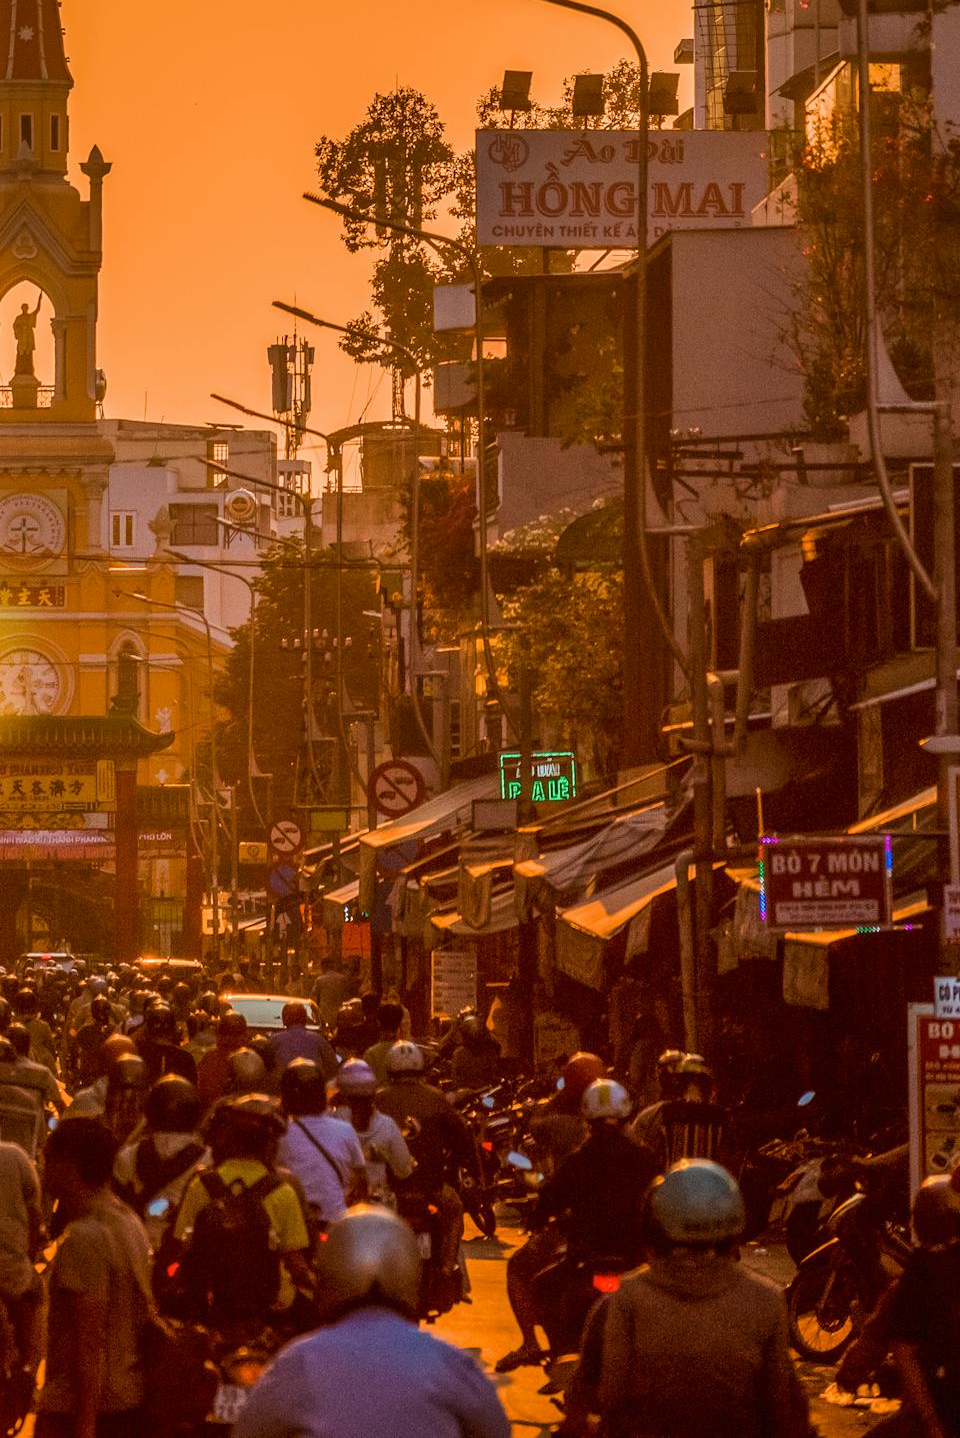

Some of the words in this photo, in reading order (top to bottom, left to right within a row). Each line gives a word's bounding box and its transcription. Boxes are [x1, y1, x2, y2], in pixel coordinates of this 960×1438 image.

[560, 133, 616, 166] Áo
[622, 139, 685, 164] Dài
[499, 162, 638, 218] HỒNG
[651, 181, 746, 218] MAI
[492, 223, 554, 238] CHUYÊN
[771, 849, 802, 876] BÒ
[807, 854, 822, 875] 7
